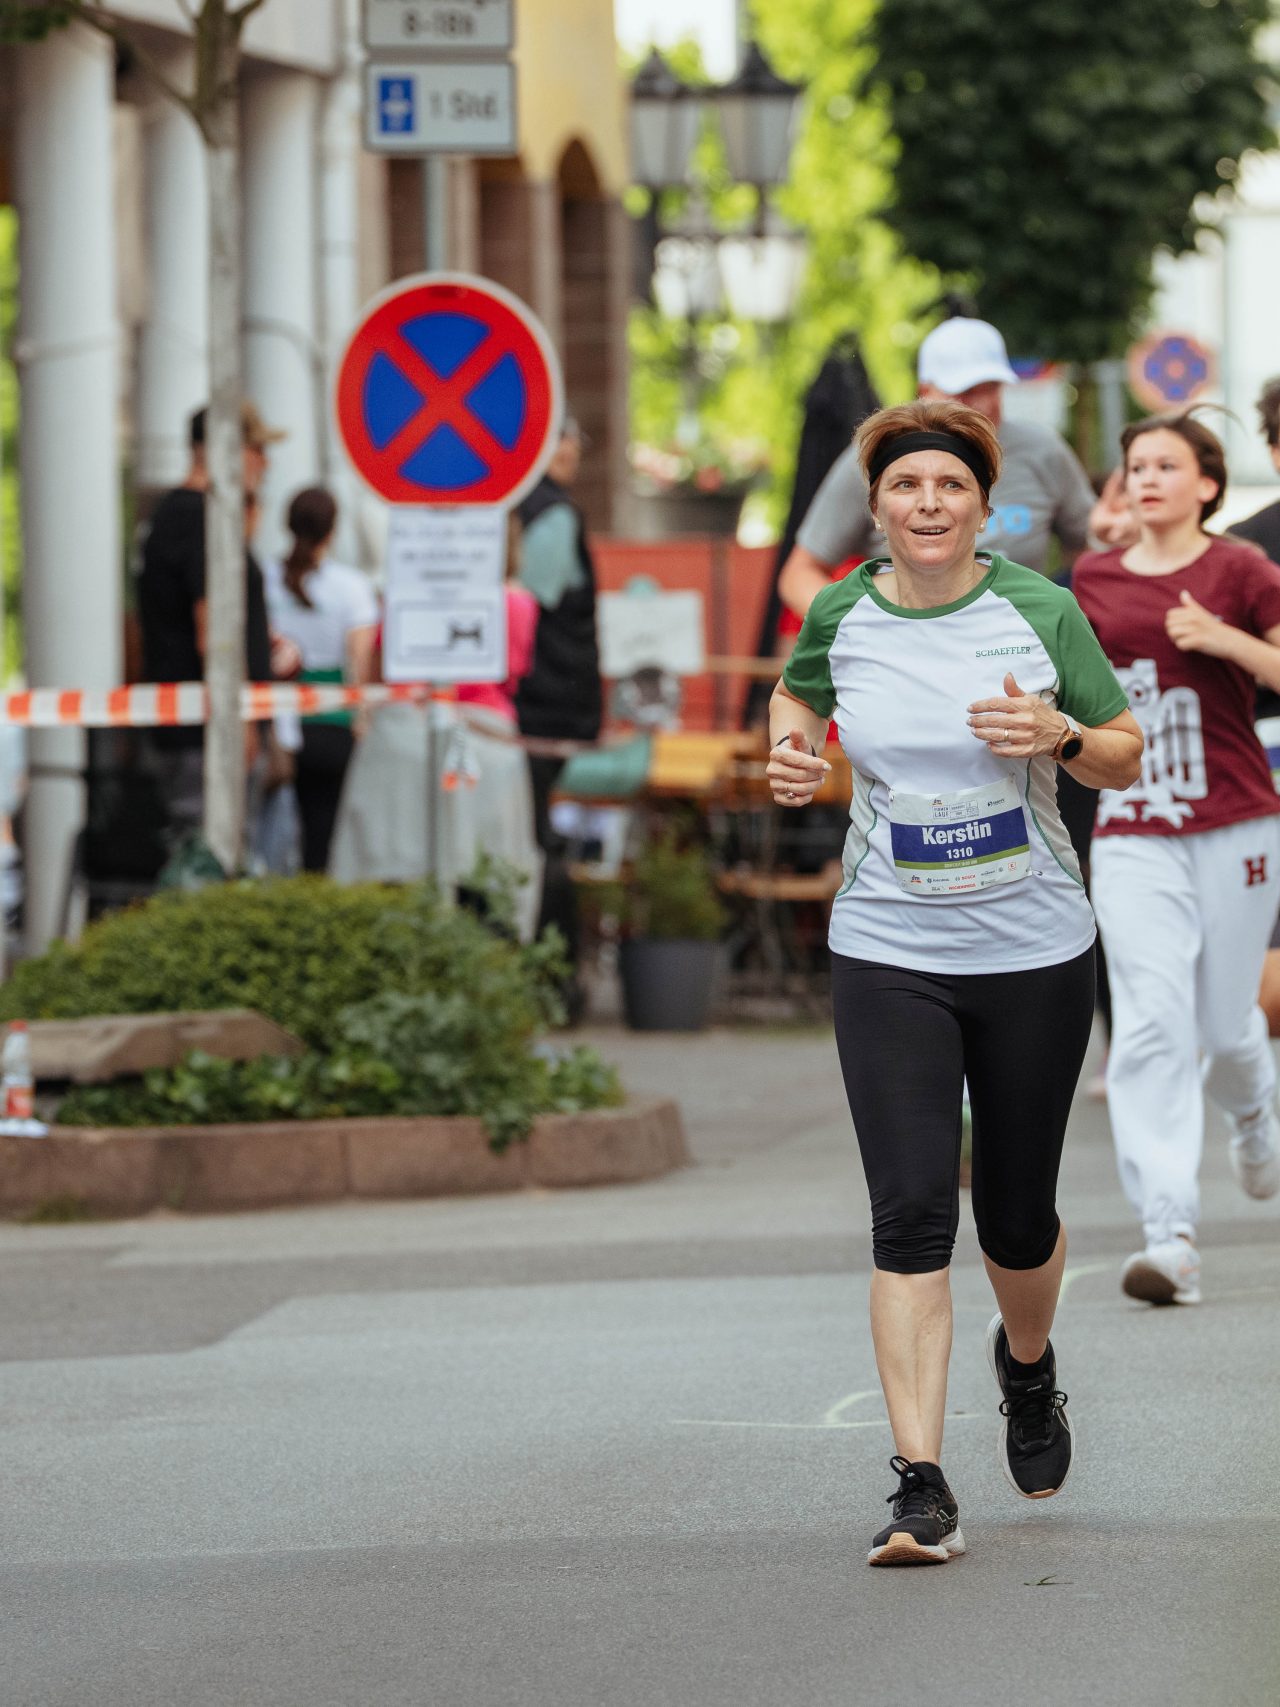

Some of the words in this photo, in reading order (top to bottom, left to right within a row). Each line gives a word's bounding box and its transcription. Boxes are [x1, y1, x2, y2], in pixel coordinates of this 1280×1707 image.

[975, 646, 1031, 657] SCHAEFFLER
[922, 822, 992, 845] Kerstin
[946, 847, 973, 859] 1310
[1245, 855, 1267, 885] H
